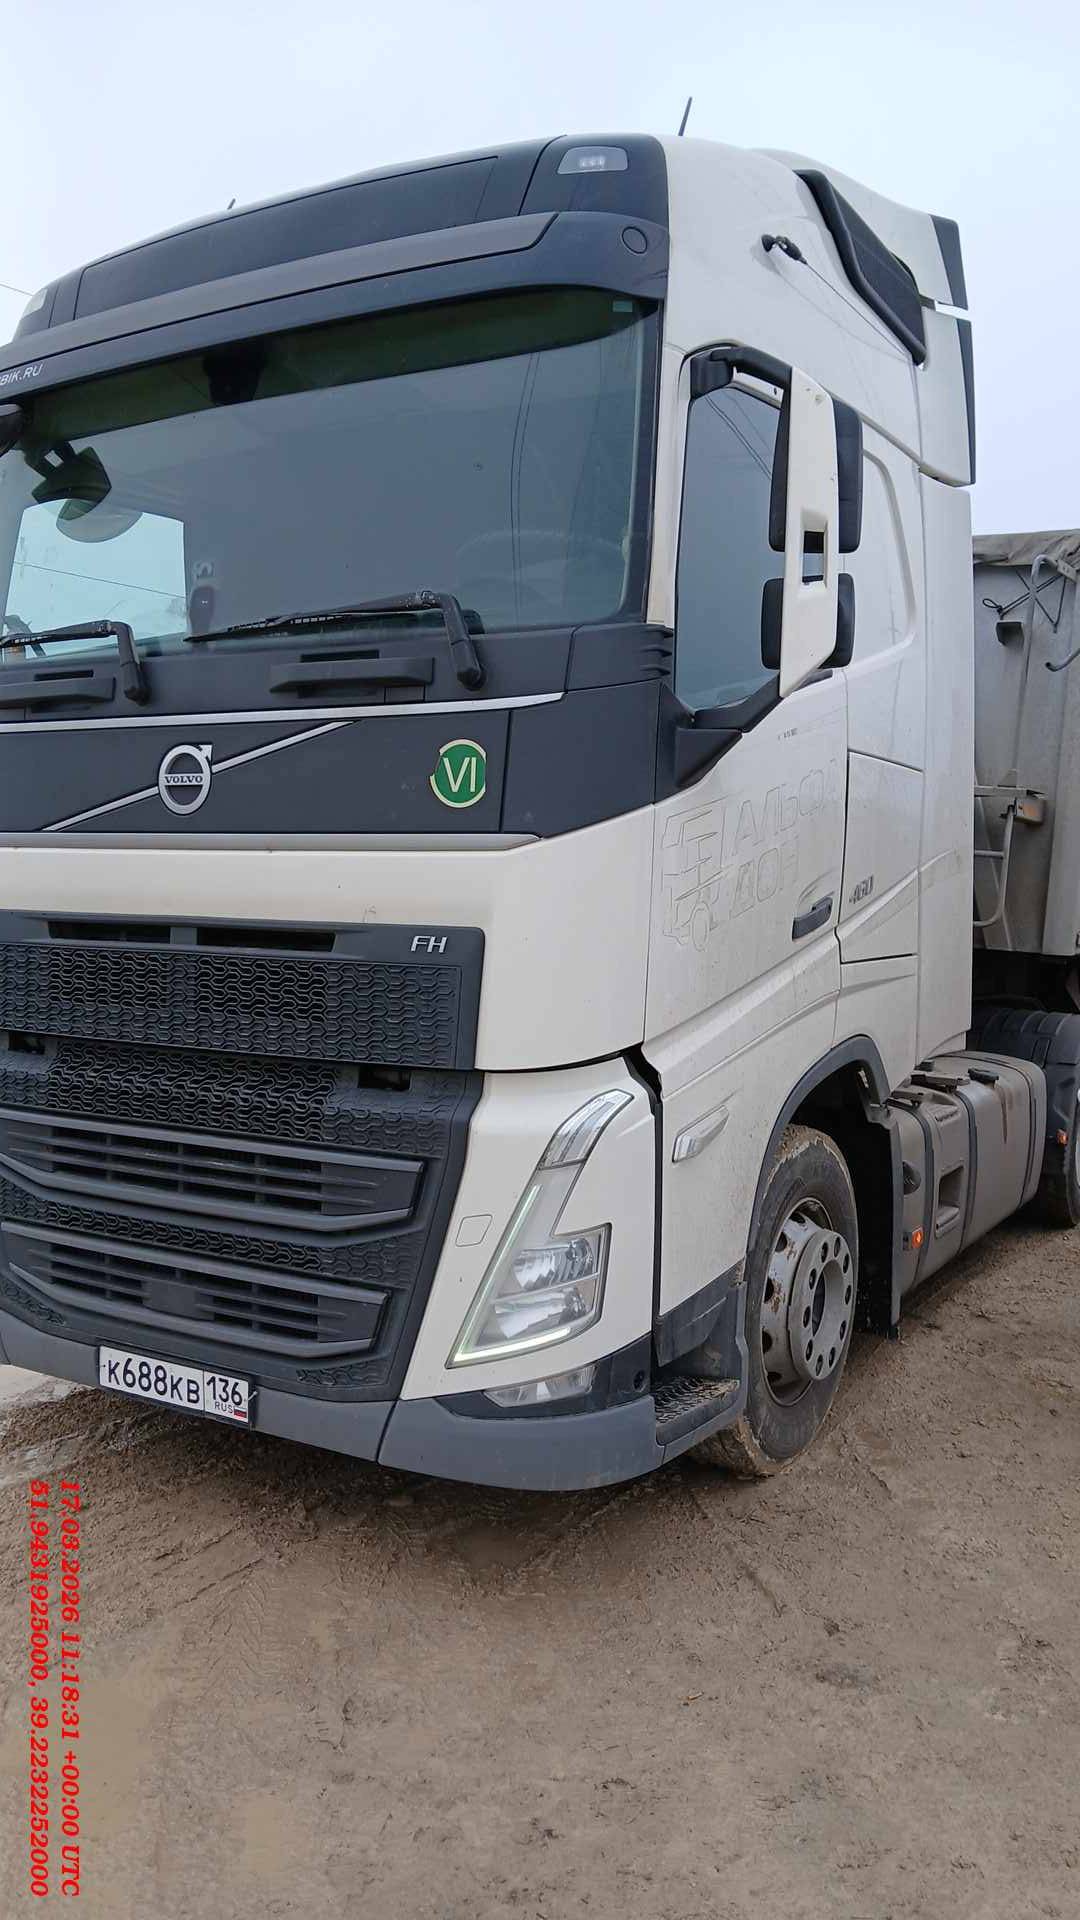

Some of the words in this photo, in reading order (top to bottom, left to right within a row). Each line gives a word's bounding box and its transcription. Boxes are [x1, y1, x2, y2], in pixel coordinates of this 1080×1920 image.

[0, 363, 44, 386] BIK.RU
[164, 775, 204, 784] VOLVO
[442, 756, 477, 793] VI
[410, 935, 448, 953] FH
[206, 1375, 243, 1406] 136
[214, 1402, 233, 1414] RUS
